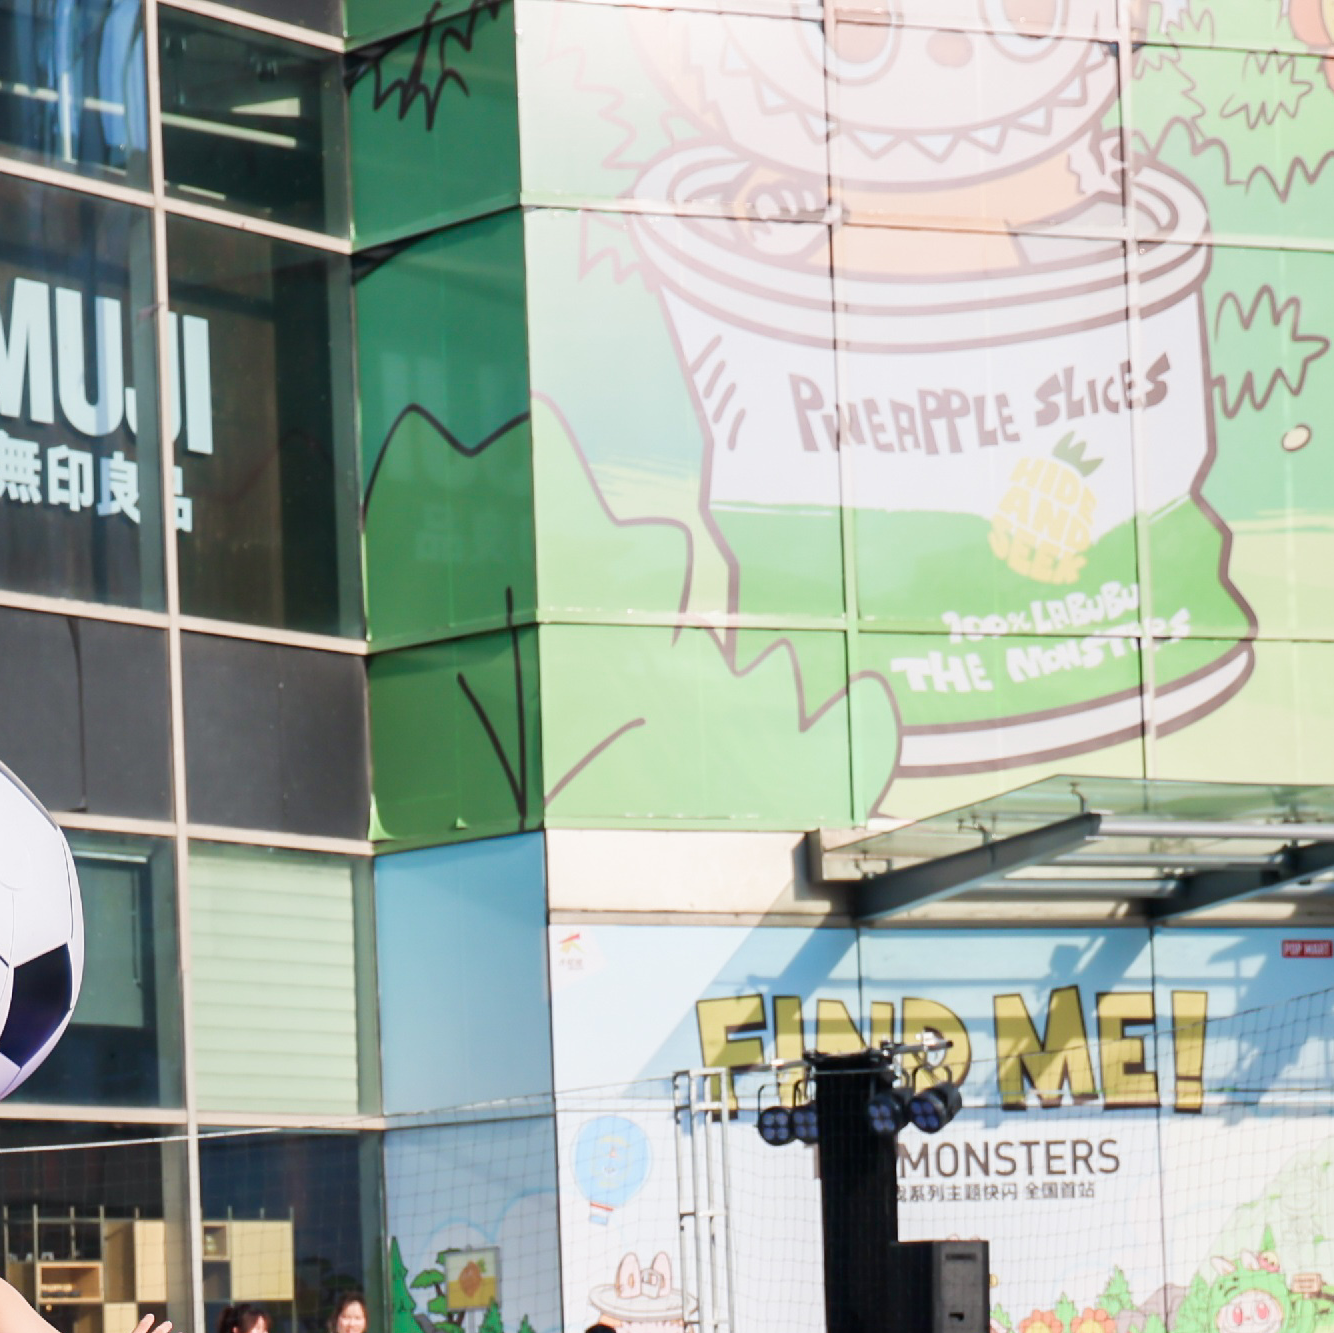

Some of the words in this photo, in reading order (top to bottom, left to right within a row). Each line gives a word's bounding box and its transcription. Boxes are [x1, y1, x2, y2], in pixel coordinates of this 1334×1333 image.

[789, 373, 1021, 455] PINEAPPLE
[1034, 352, 1171, 427] SLICES
[998, 486, 1093, 548] AND
[1009, 457, 1098, 528] HIDE
[988, 521, 1088, 585] SEEK
[890, 650, 994, 692] THE
[993, 984, 1208, 1113] ME!
[898, 1139, 1121, 1178] MONSTERS
